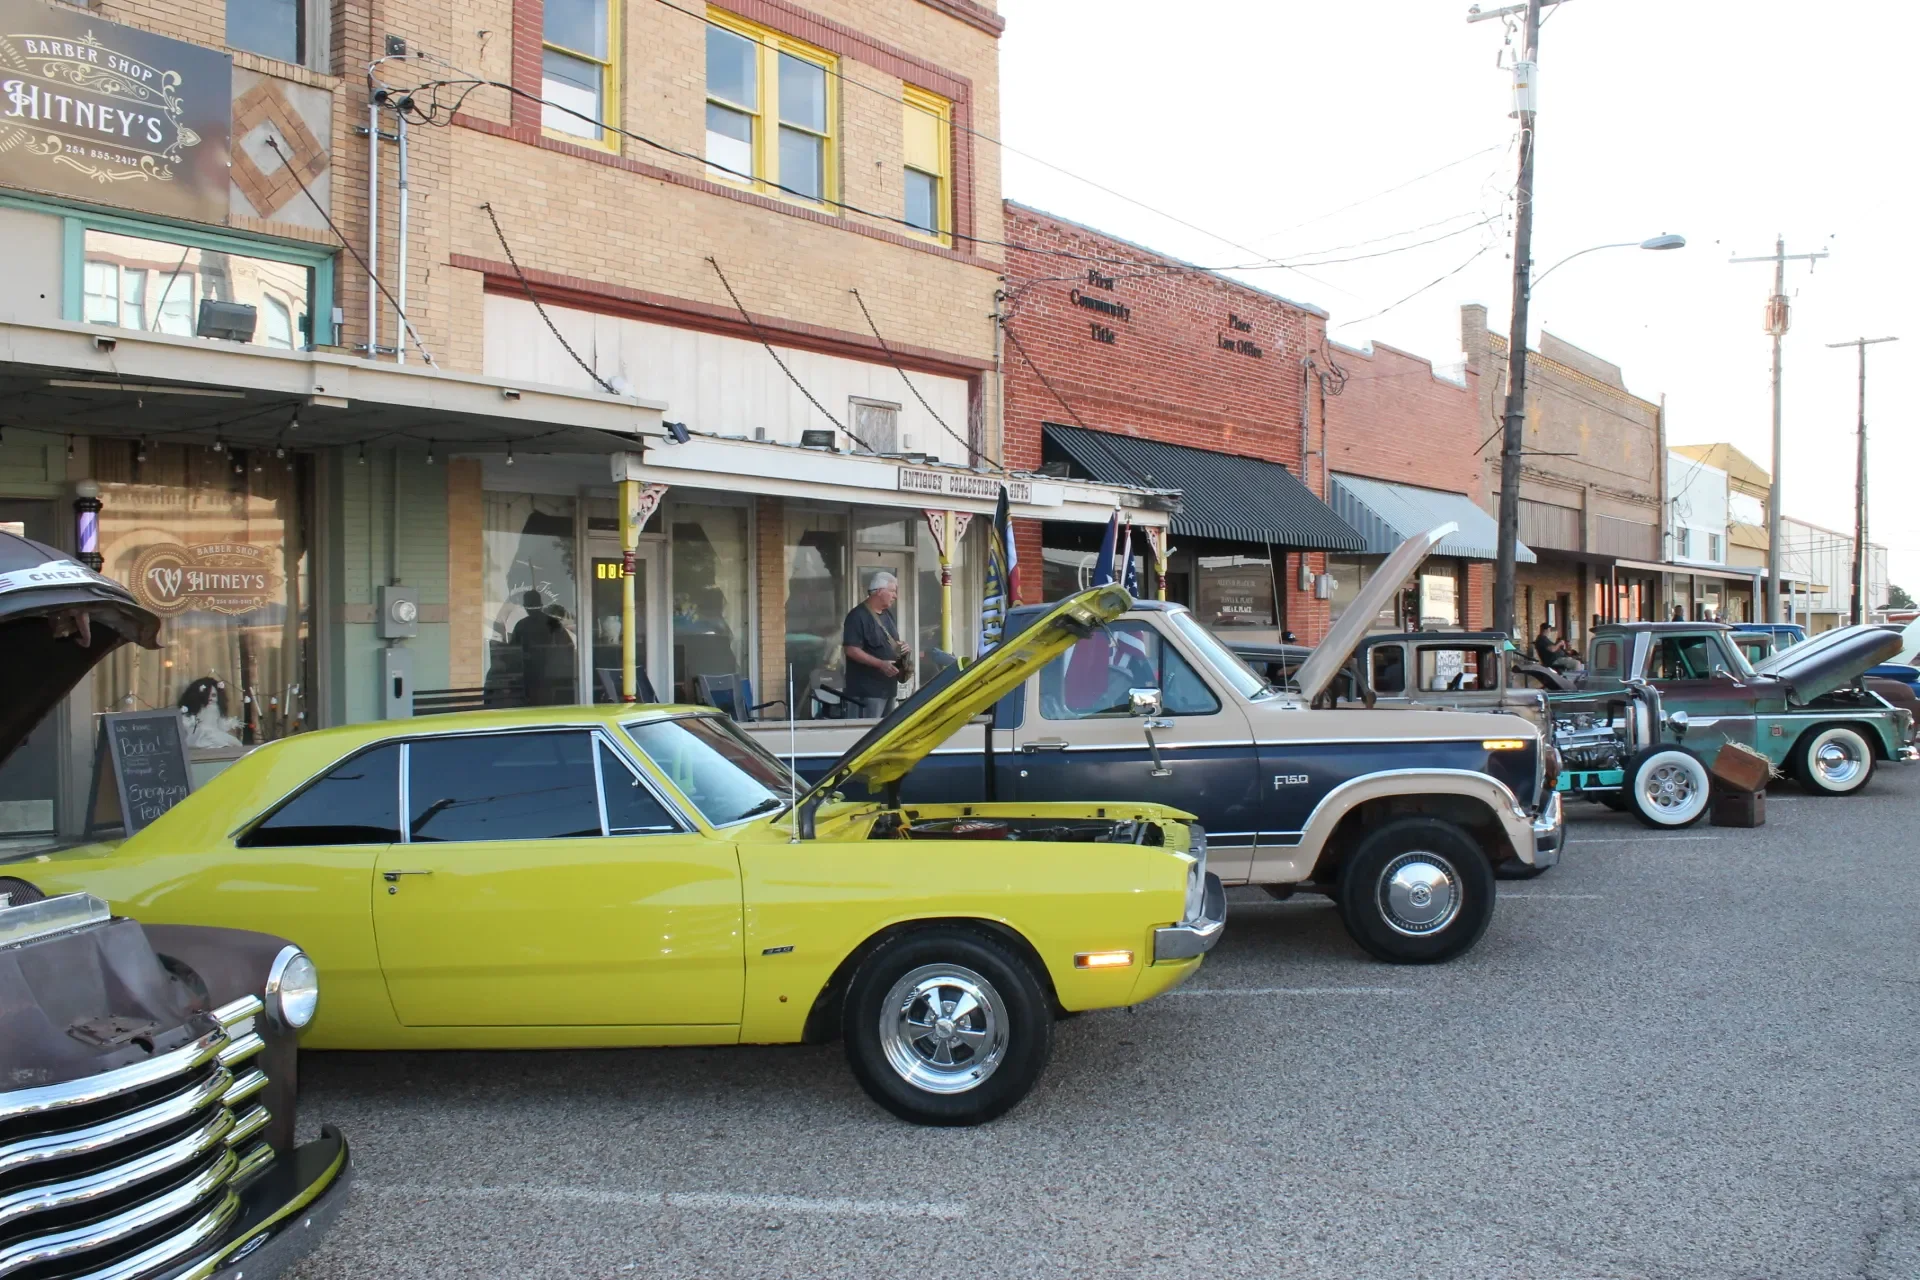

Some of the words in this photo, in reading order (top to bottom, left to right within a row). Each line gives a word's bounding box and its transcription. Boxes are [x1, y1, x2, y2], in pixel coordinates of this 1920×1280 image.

[25, 39, 98, 63] BARBER
[108, 55, 153, 81] SHOP
[3, 79, 163, 143] HITNEY'S
[65, 144, 85, 156] 254
[90, 149, 138, 167] 855-2412
[1070, 288, 1131, 322] Community
[1089, 323, 1115, 345] Title
[950, 475, 1001, 497] COLLECTIBLES
[196, 544, 232, 556] BARBER
[235, 545, 259, 557] SHOP
[129, 784, 188, 803] Energizing
